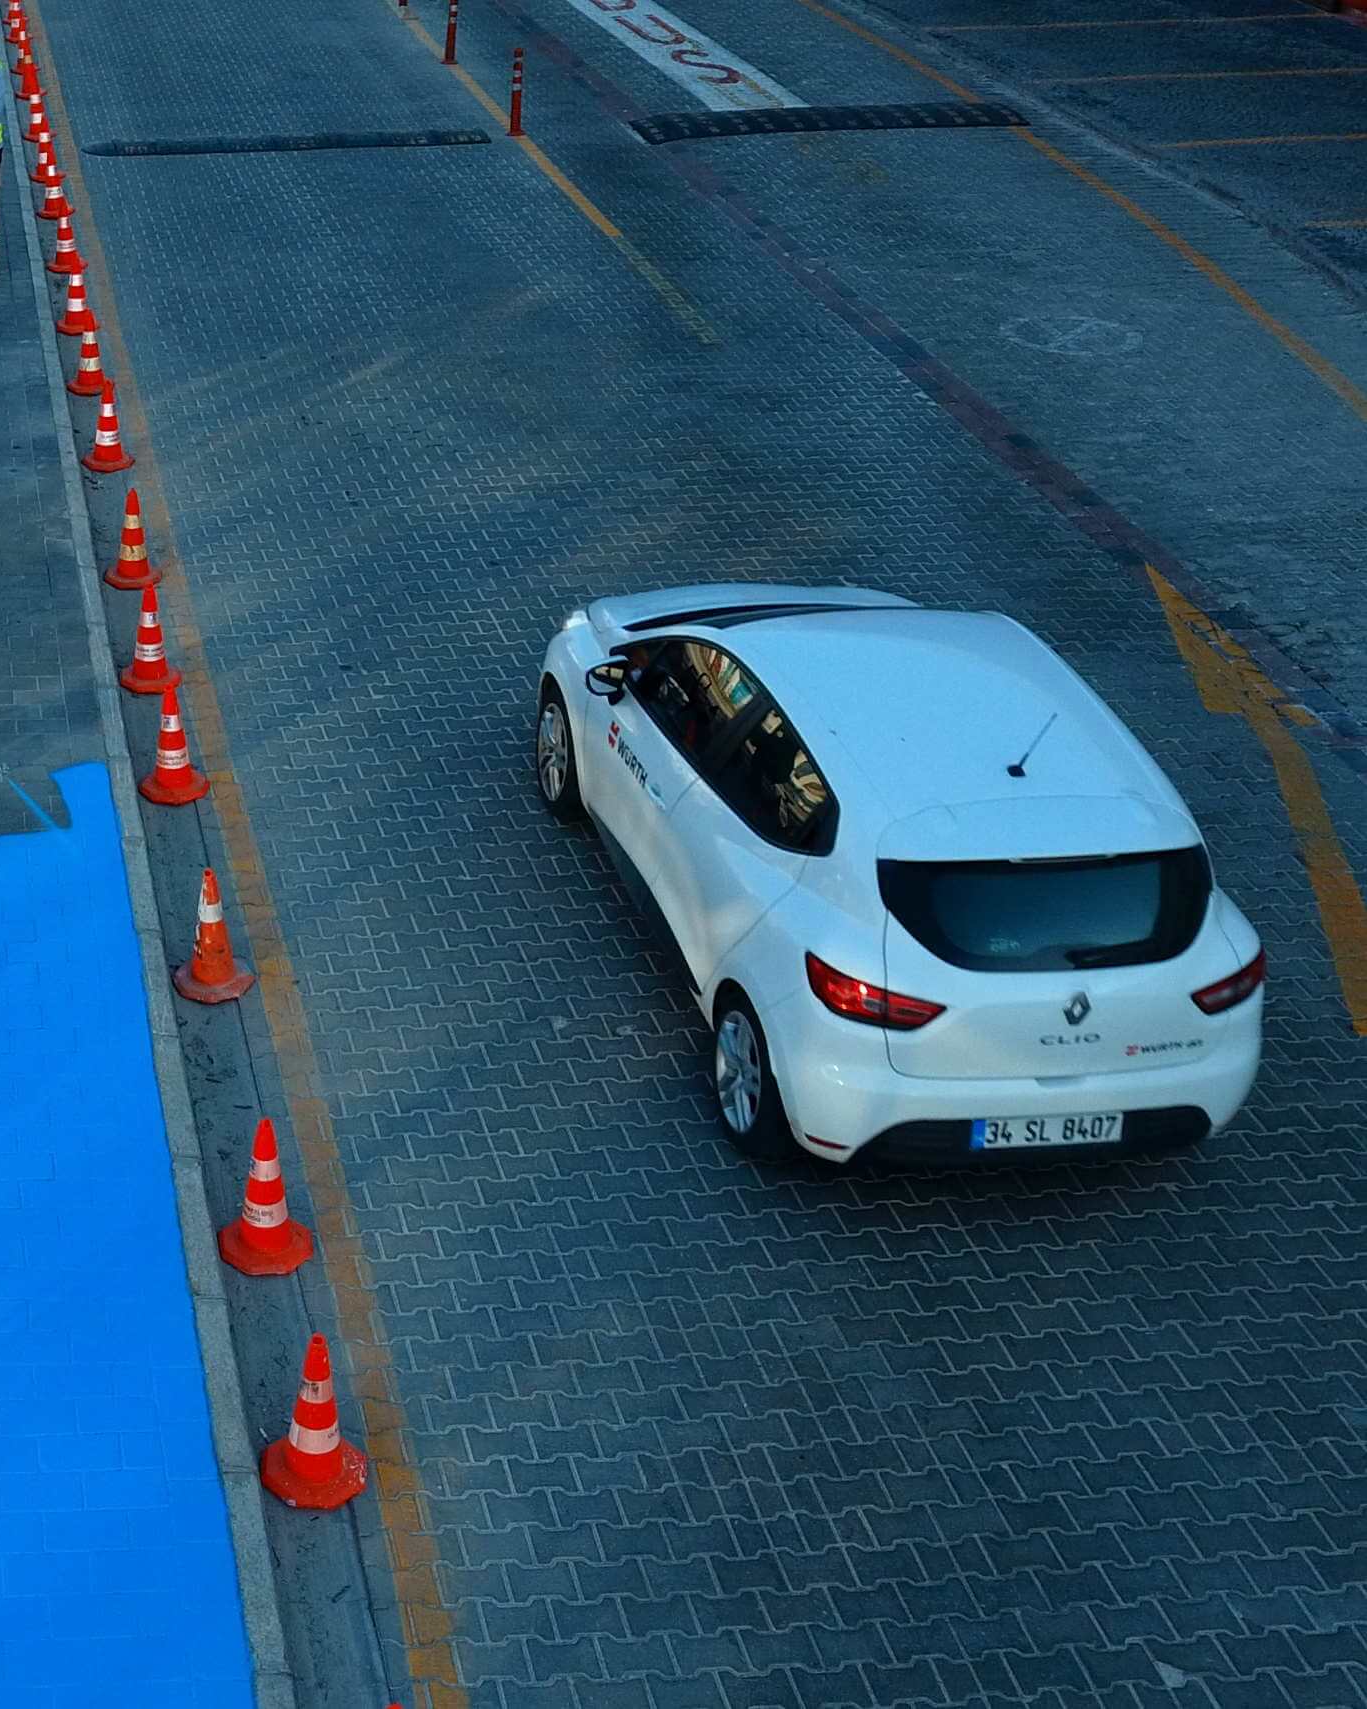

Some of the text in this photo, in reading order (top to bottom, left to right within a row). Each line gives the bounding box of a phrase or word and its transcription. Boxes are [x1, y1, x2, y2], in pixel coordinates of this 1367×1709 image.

[617, 736, 648, 789] WÜRTH
[1040, 1032, 1101, 1046] CLIO
[985, 1115, 1118, 1144] 34 SL 8407
